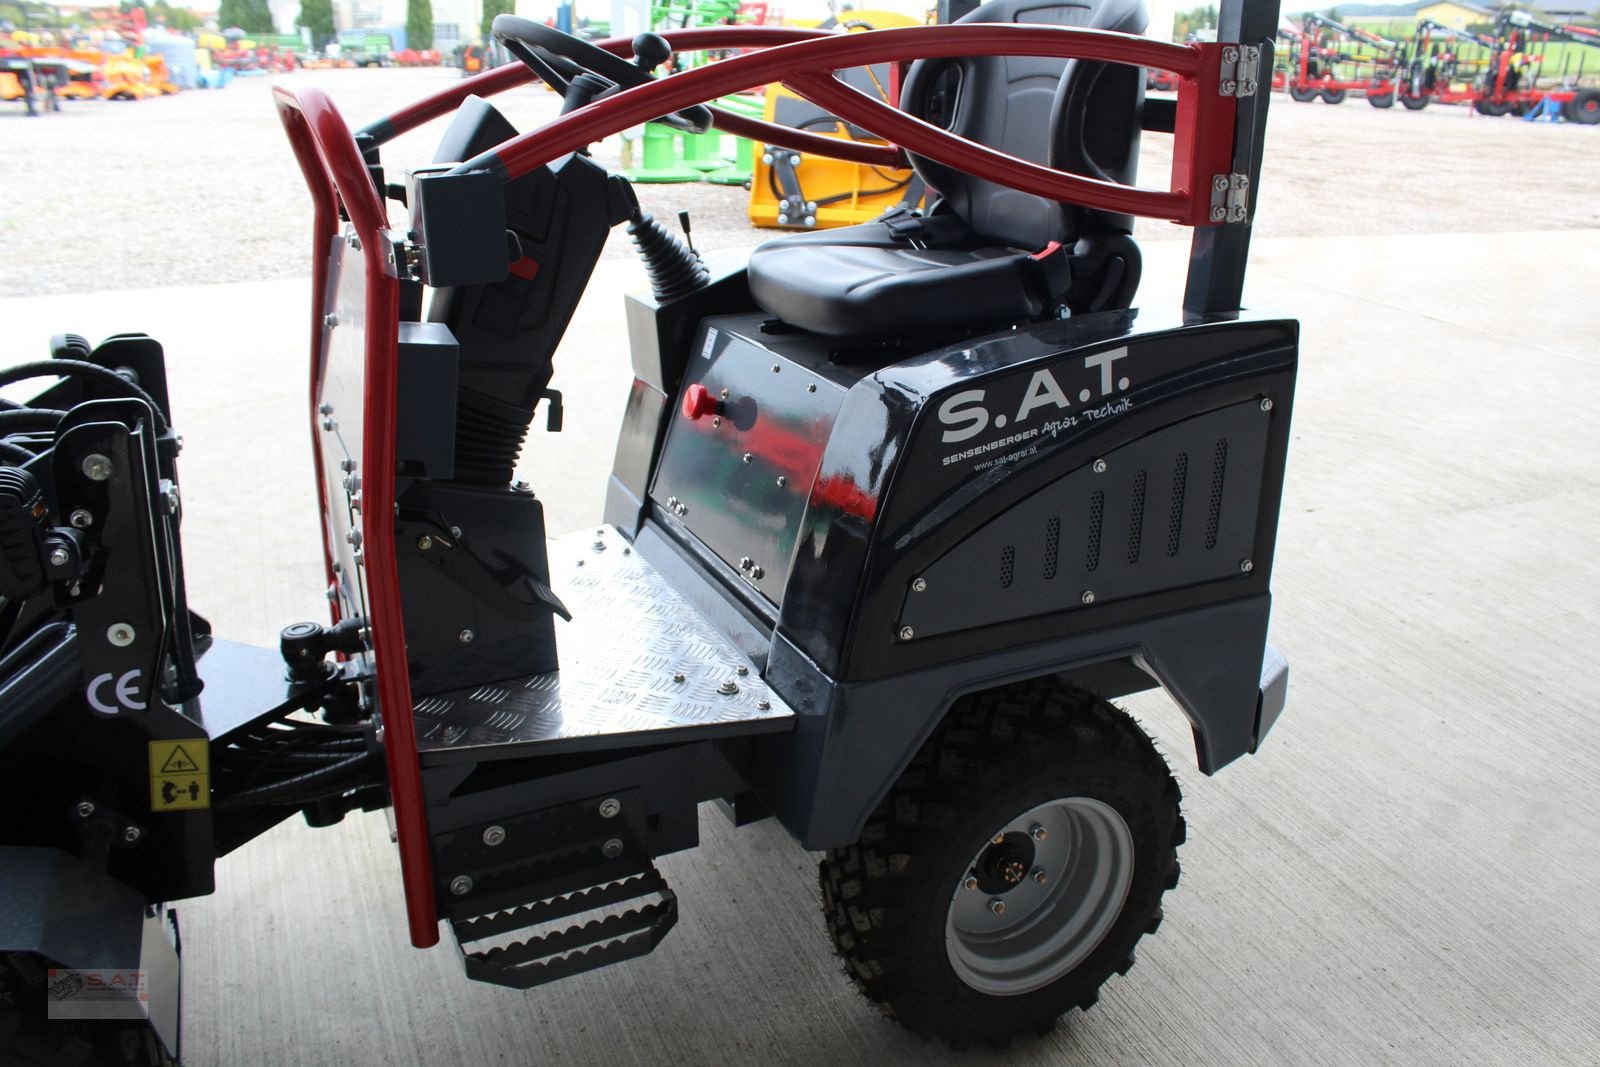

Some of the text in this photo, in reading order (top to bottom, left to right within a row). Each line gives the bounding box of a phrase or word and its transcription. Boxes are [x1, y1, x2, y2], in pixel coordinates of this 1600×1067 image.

[938, 346, 1130, 443] S.A.T.
[942, 397, 1133, 466] SENSENBERGER Agrar Technik
[974, 446, 1037, 472] www.sat-agrar.at
[87, 669, 147, 714] CE
